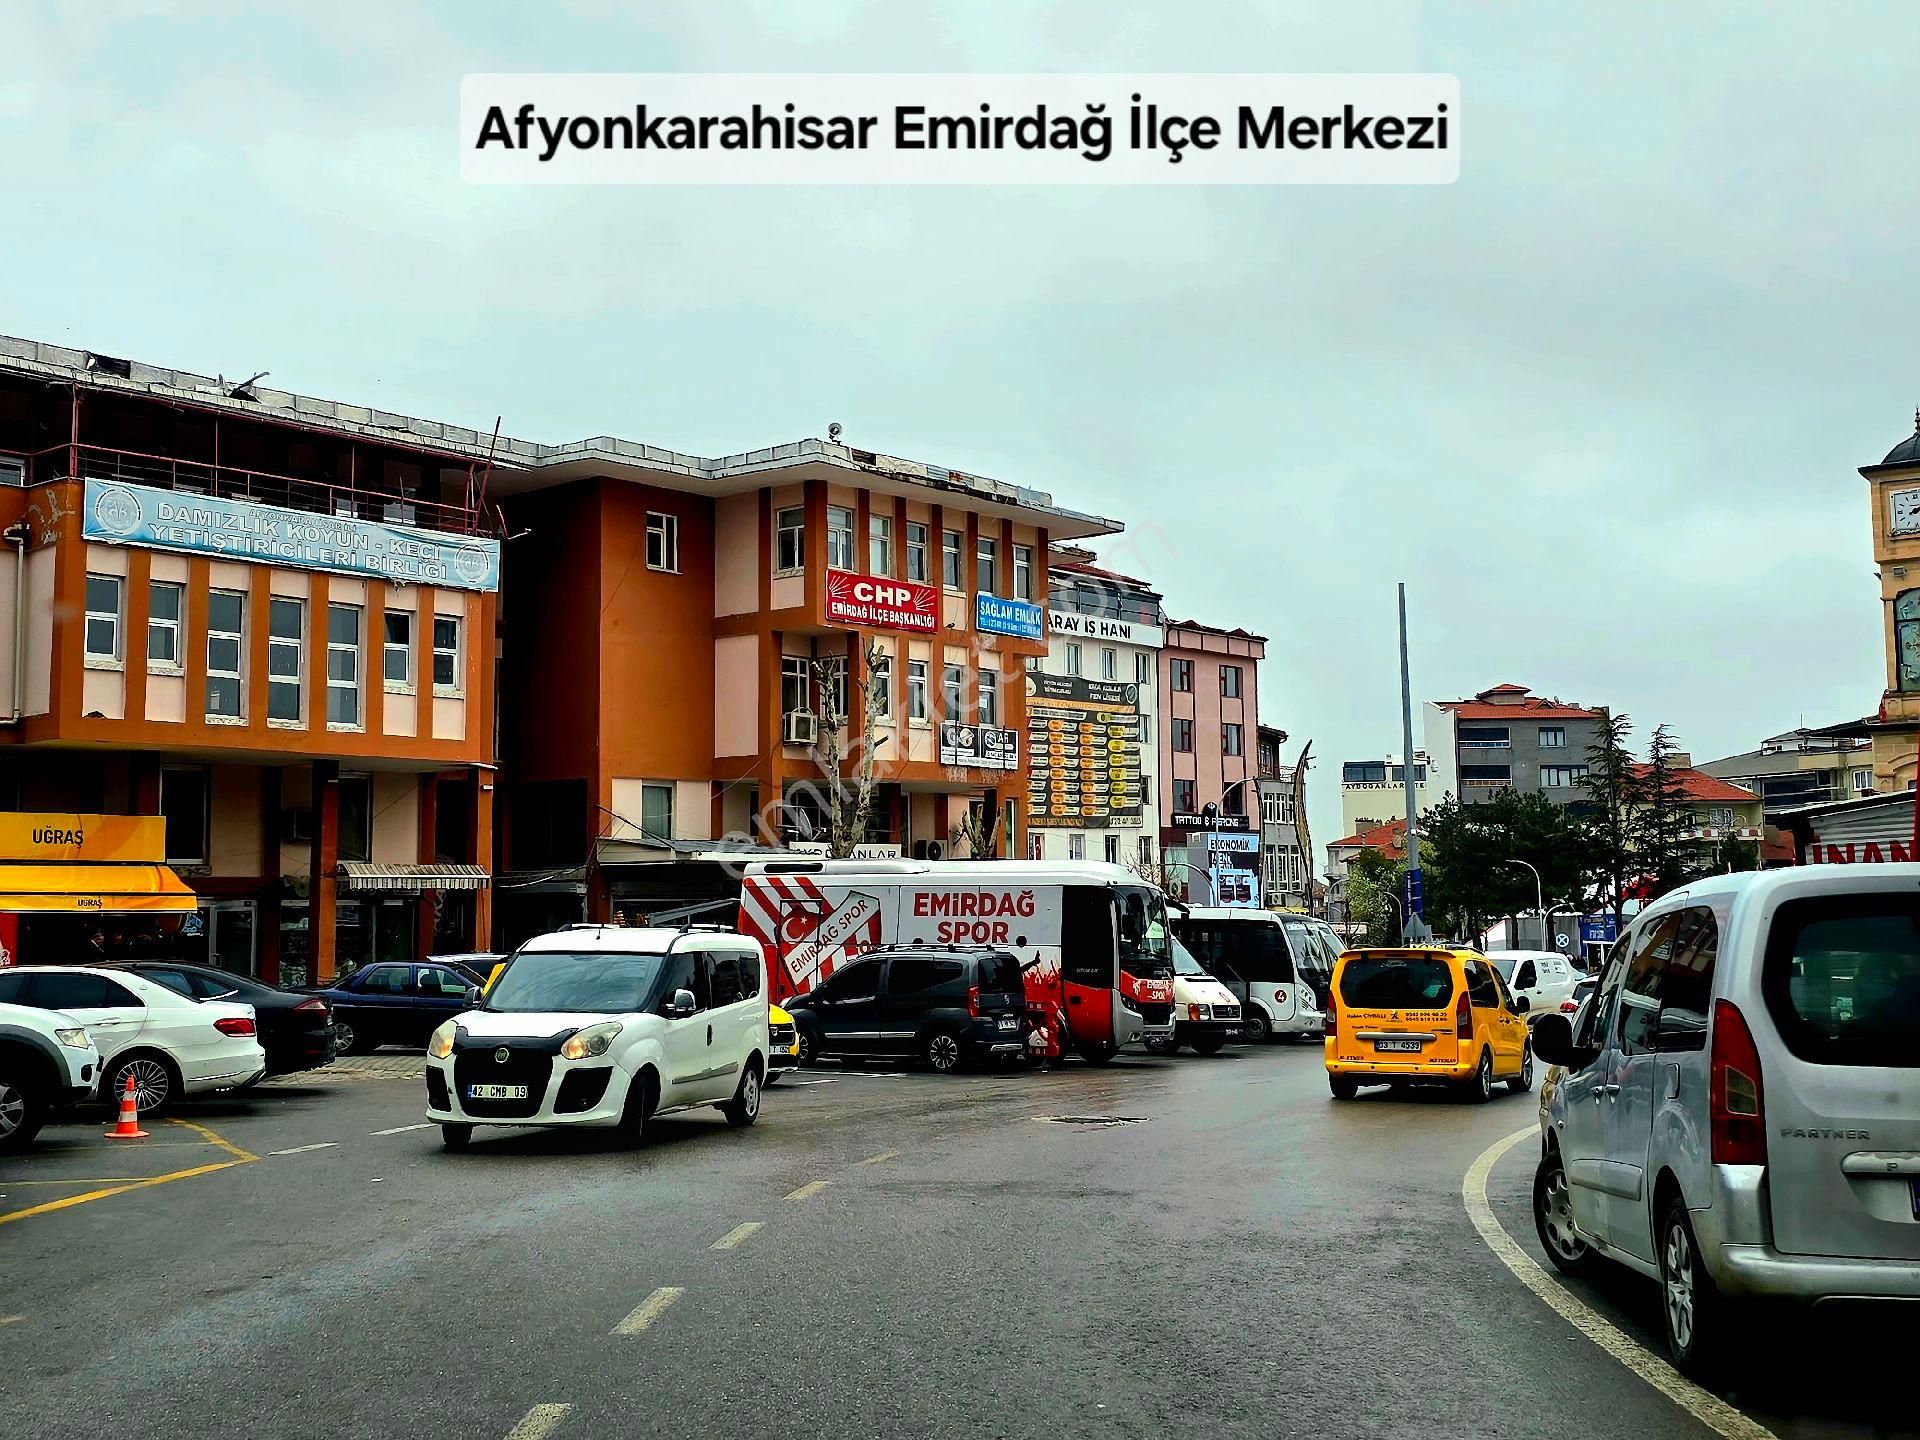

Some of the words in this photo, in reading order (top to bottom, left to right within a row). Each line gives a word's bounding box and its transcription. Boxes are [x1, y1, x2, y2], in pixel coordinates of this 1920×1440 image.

[148, 522, 357, 567] YETİŞTİRİCİLERİ
[365, 553, 447, 580] BİRLİĞİ
[287, 522, 369, 550] KOYUN
[389, 538, 441, 564] KEÇİ
[853, 582, 912, 607] CHP
[831, 601, 868, 619] EMİRDAĞ
[869, 605, 888, 624] İLÇE
[889, 611, 935, 629] BAŞKANLIĞI
[980, 600, 1013, 620] SAĞLAM
[1014, 607, 1041, 625] EMLAK
[1084, 617, 1096, 636] İŞ
[1100, 622, 1131, 639] HANI
[1174, 815, 1202, 825] TATTOO
[32, 825, 84, 849] UĞRAŞ
[913, 889, 1036, 918] EMİRDAĞ
[789, 922, 839, 974] EMİRDAĞ
[838, 899, 869, 929] SPOR
[936, 921, 1010, 944] SPOR
[1400, 1042, 1420, 1050] 4539
[472, 1086, 483, 1097] 42
[490, 1086, 507, 1098] CMB
[514, 1087, 526, 1098] 09
[1780, 1127, 1870, 1140] PARTNER
